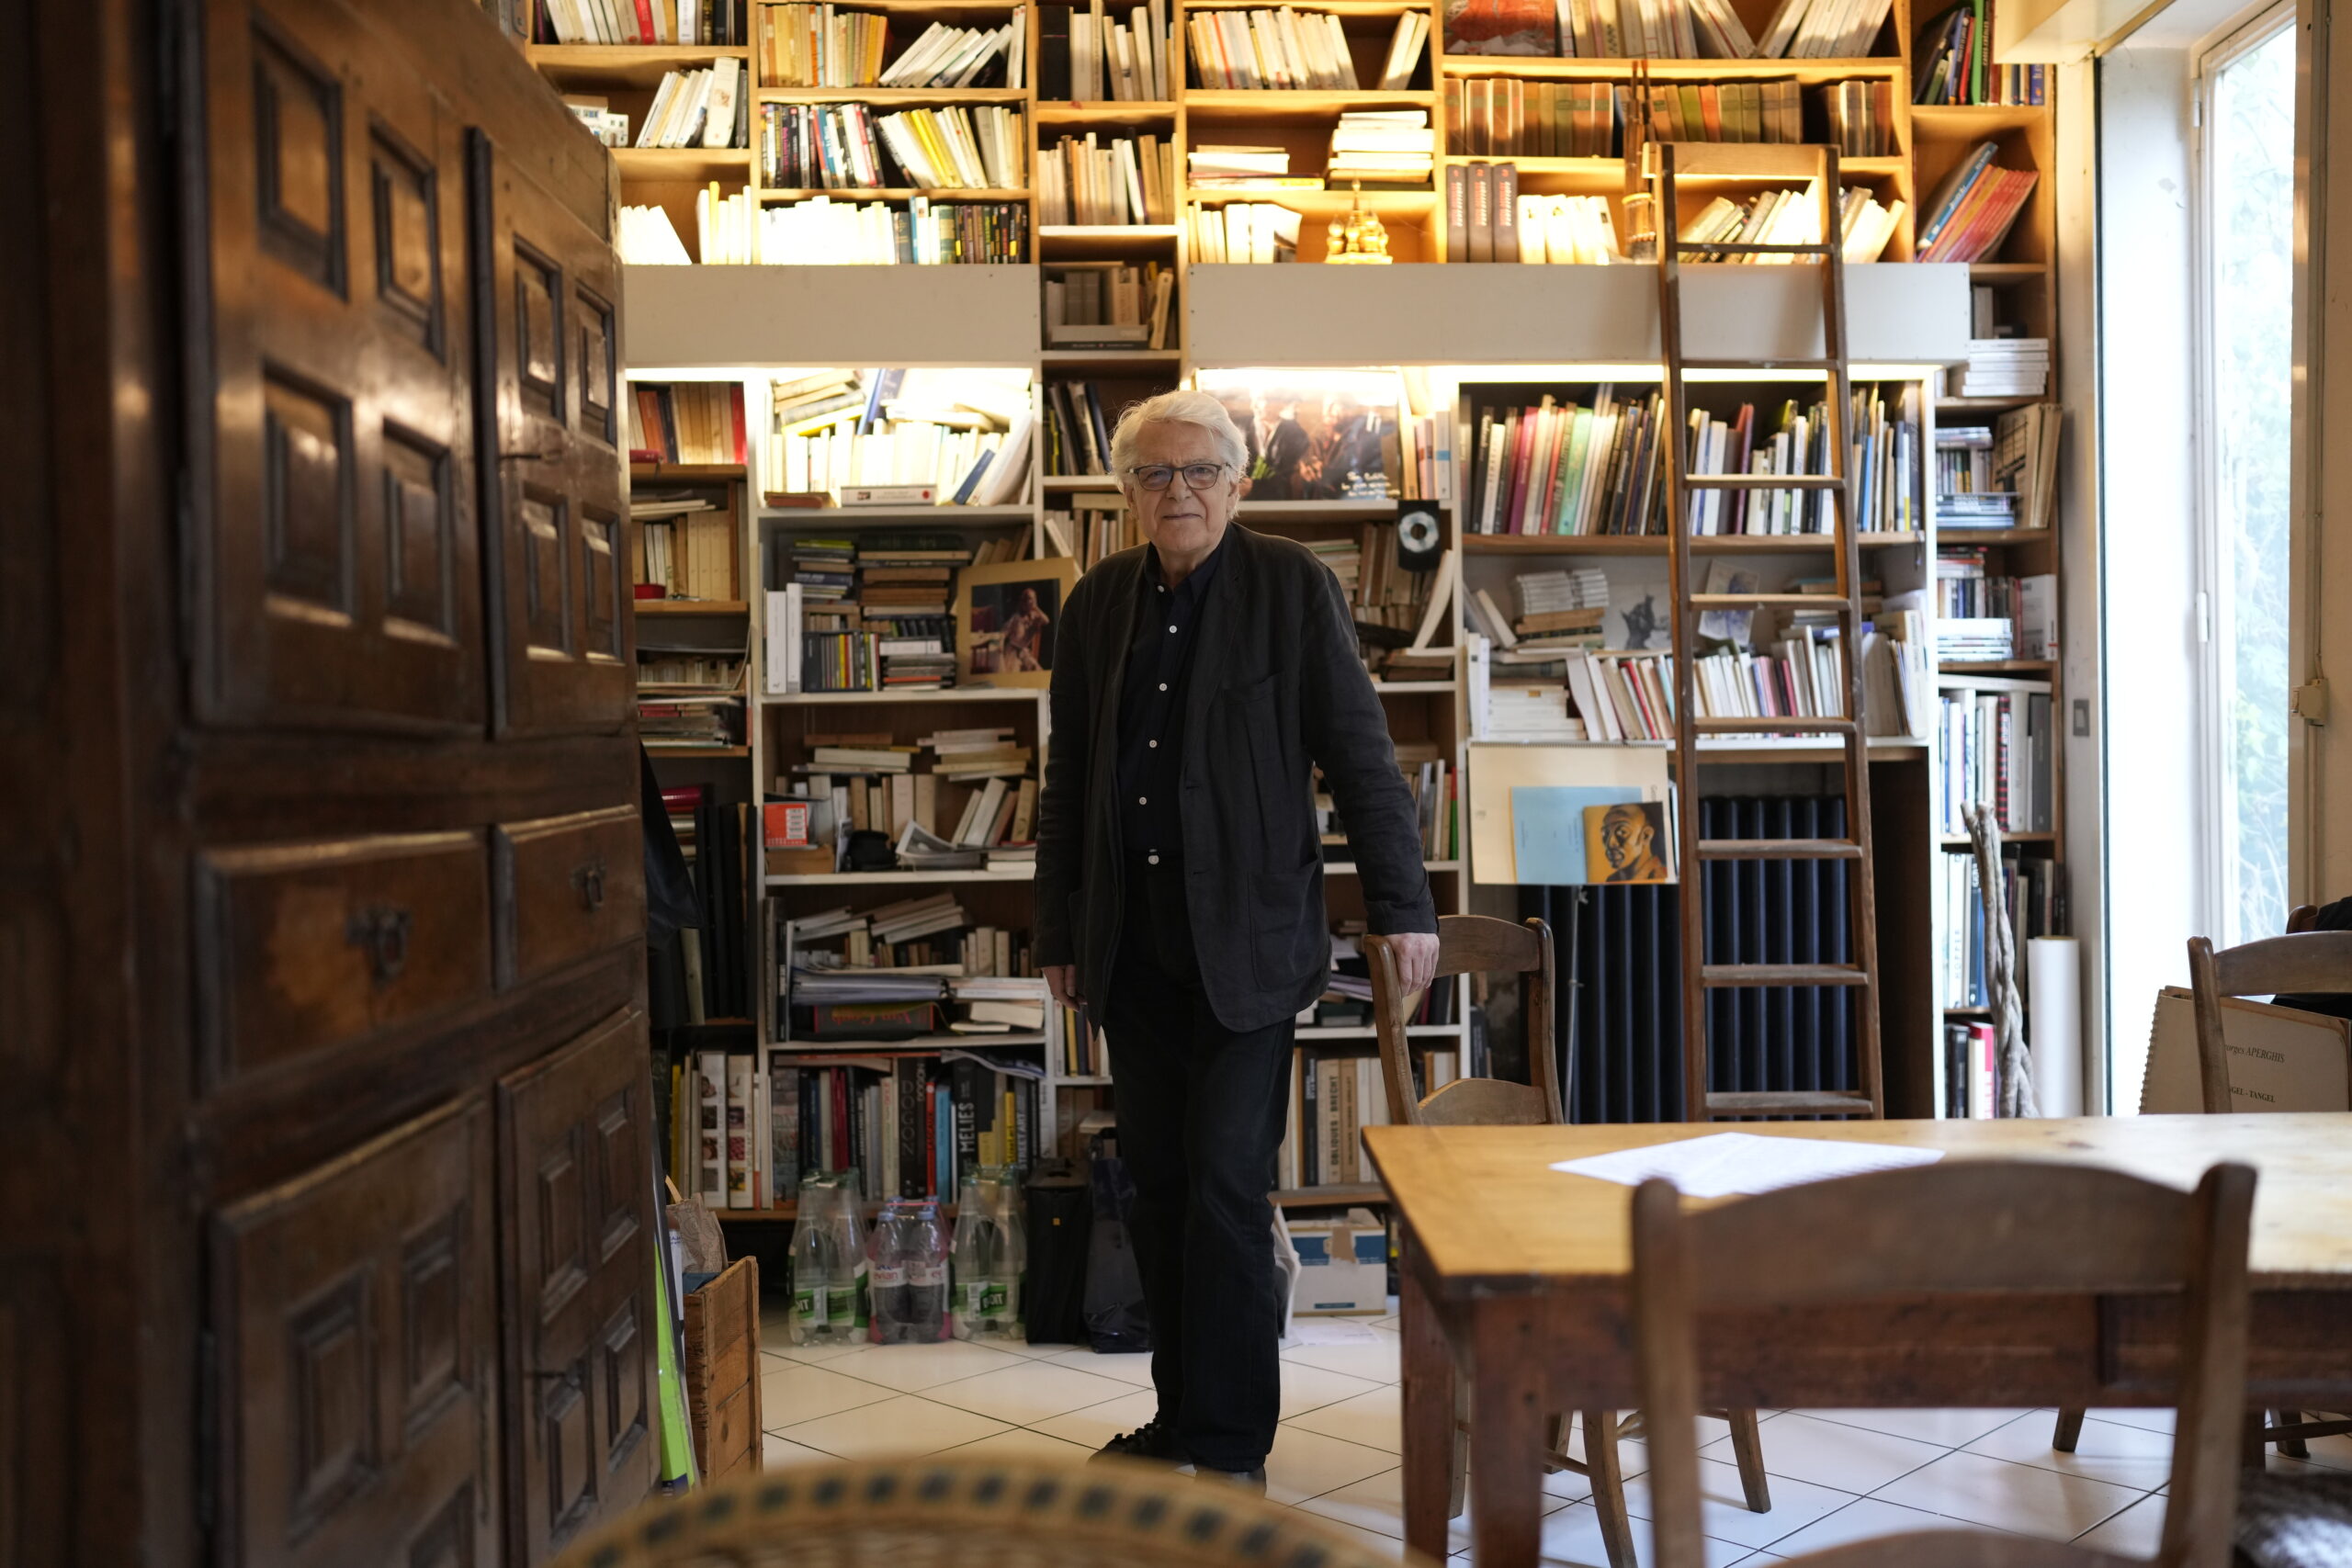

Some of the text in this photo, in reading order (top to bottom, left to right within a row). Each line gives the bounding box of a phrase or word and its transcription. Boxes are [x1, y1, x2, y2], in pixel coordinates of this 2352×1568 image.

[2245, 1046, 2285, 1064] APERGHIS
[1329, 1075, 1339, 1112] BRECHT
[2249, 1089, 2276, 1103] TANGEL
[901, 1079, 915, 1156] DOGON
[874, 1271, 899, 1280] evian
